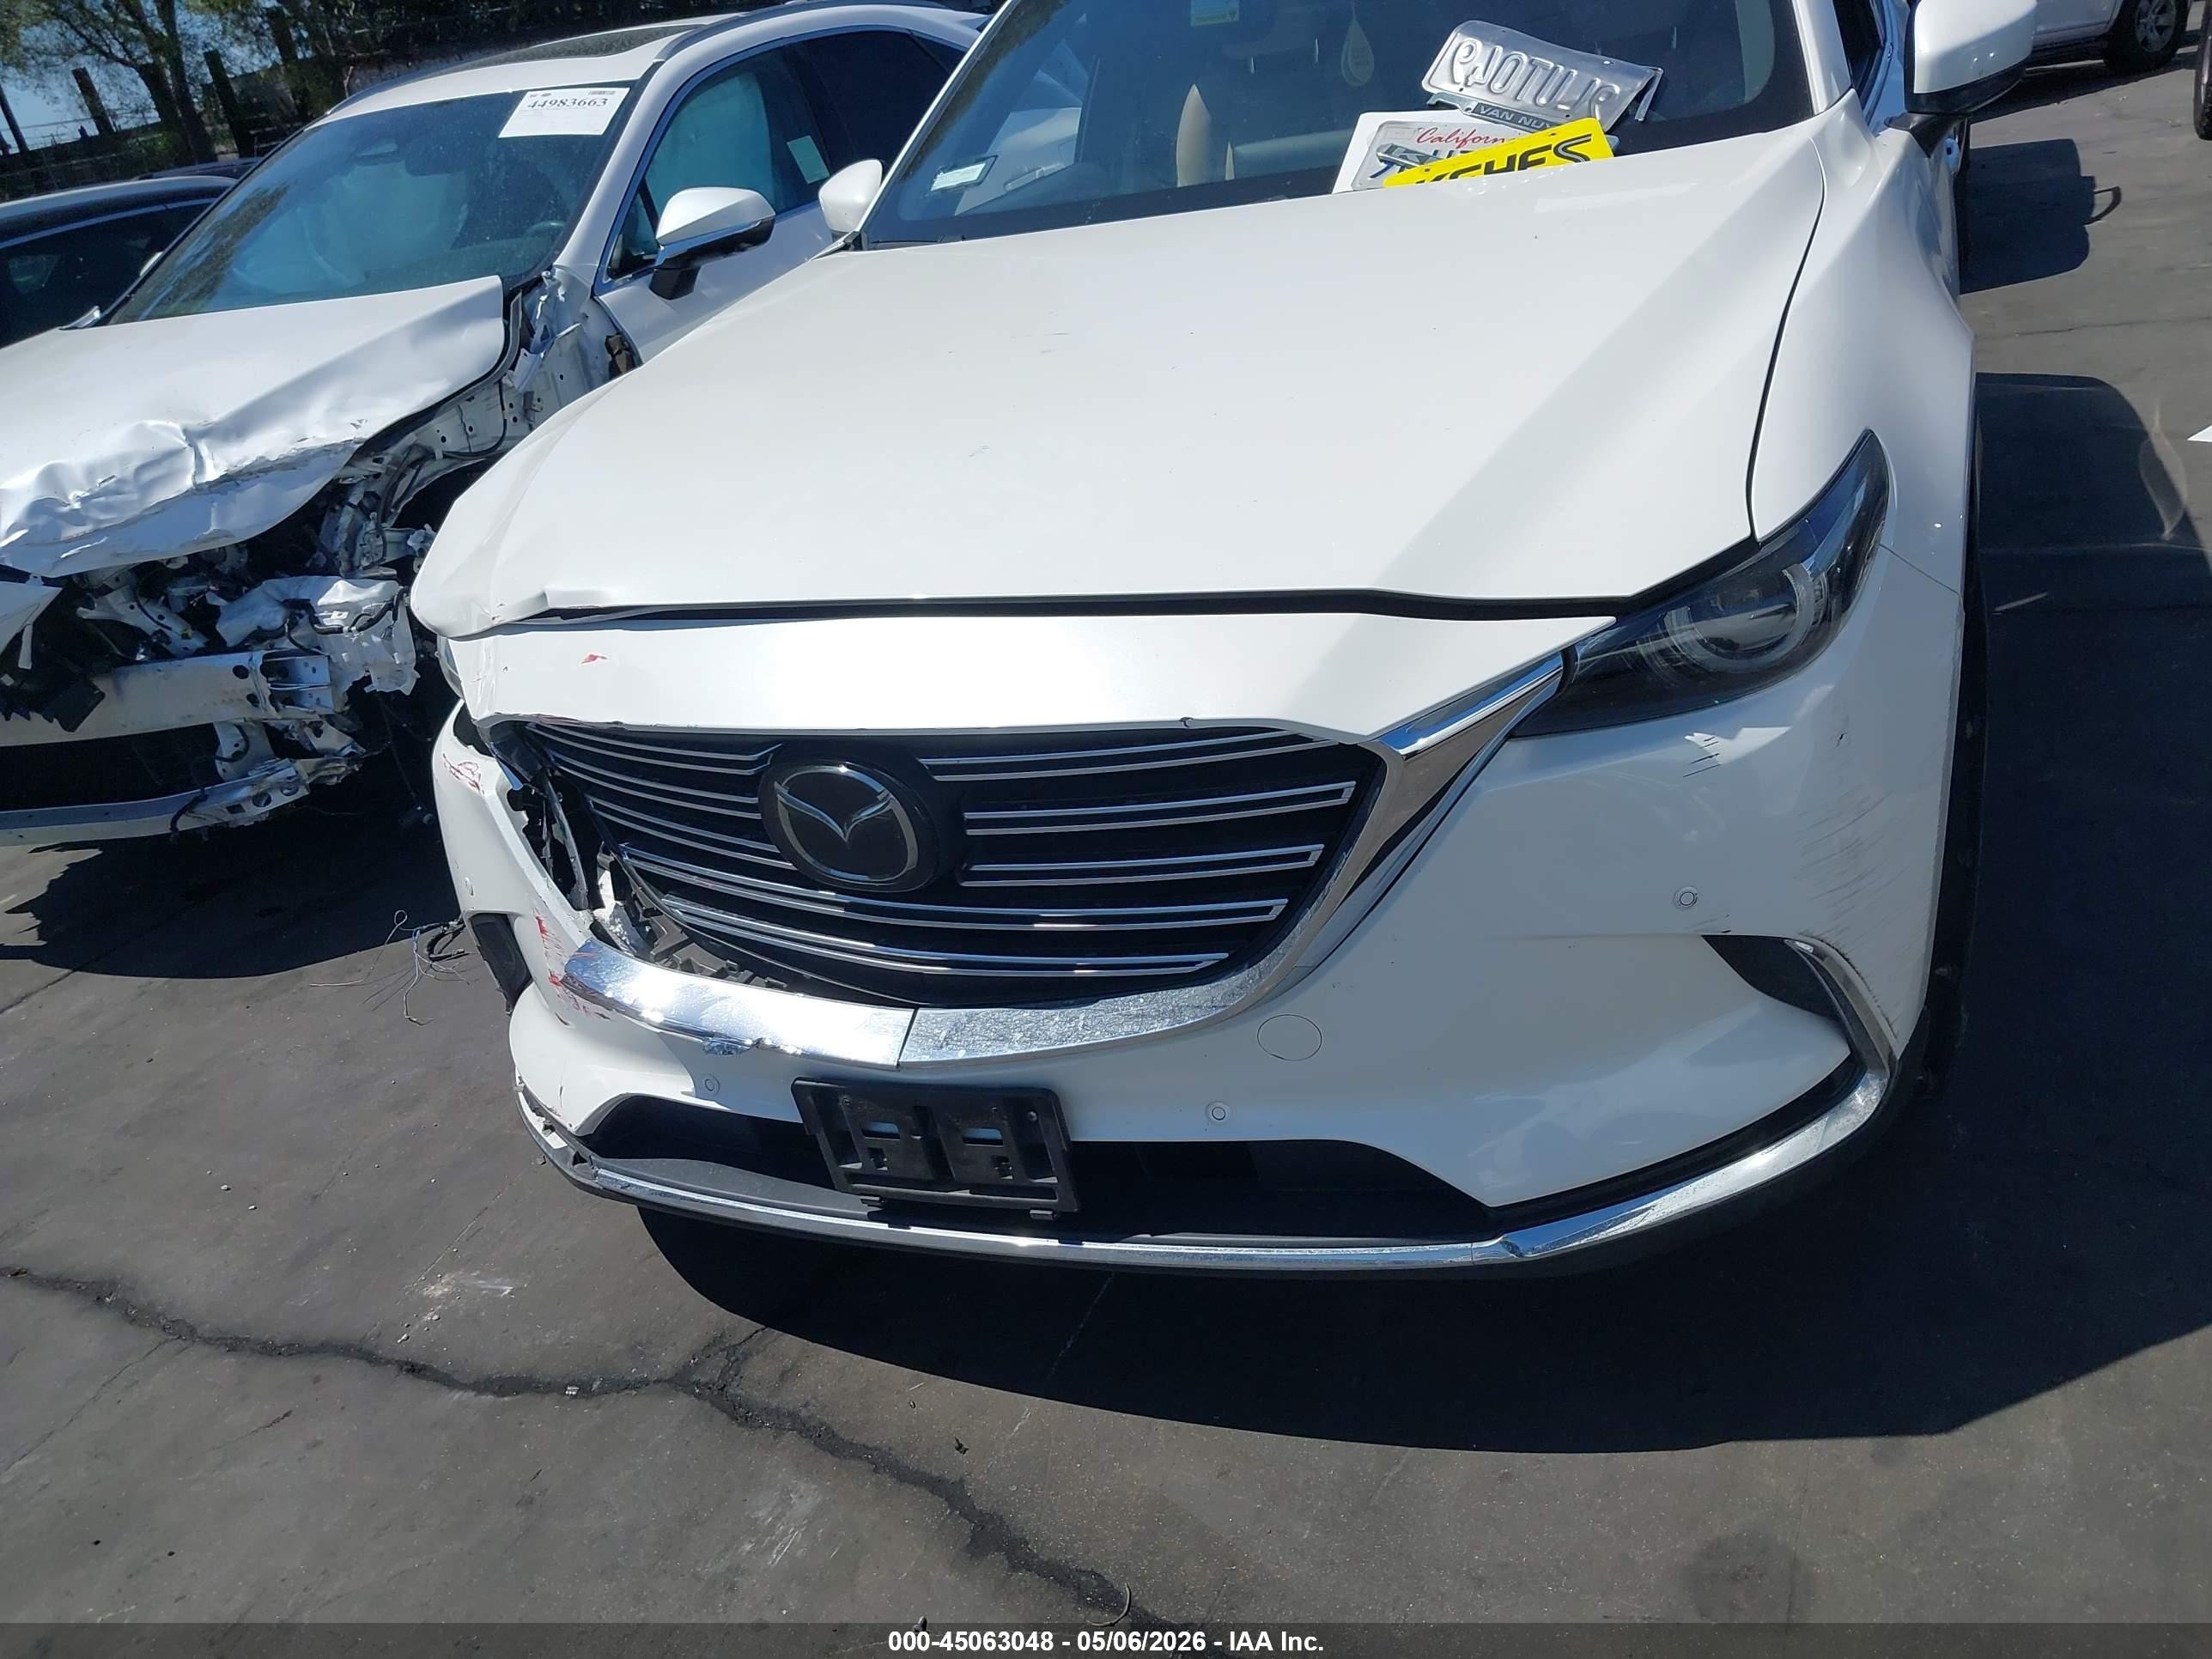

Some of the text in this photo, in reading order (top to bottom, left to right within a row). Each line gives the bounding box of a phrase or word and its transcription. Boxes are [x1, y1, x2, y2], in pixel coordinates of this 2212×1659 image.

[527, 97, 609, 109] 44983663
[1480, 105, 1515, 121] VAN
[1416, 126, 1508, 149] Californ
